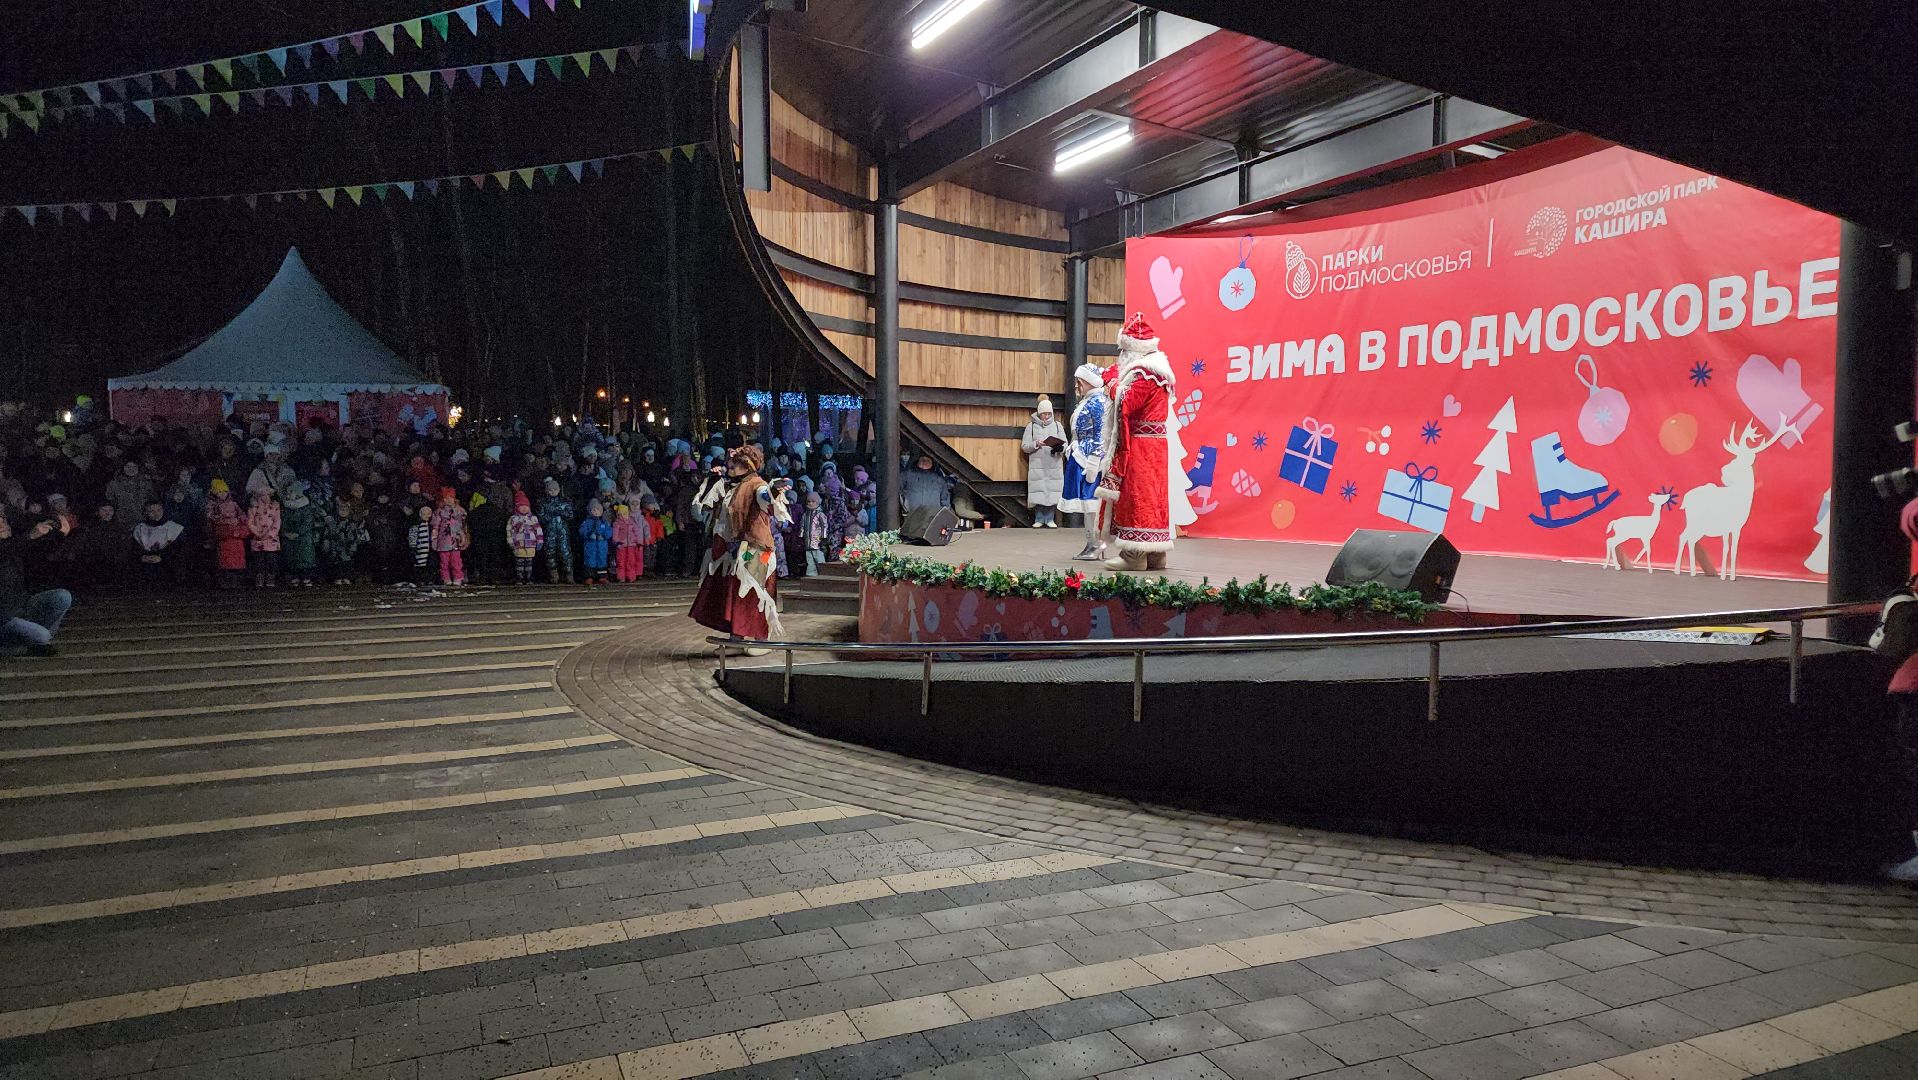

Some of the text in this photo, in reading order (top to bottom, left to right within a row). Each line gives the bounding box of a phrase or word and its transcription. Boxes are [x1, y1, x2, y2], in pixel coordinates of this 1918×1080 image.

[1576, 175, 1719, 224] ГОРОДСКОЙ ПАРК
[1574, 207, 1668, 245] КАШИРА
[1320, 249, 1473, 293] ПОДМОСКОВЬЯ
[1321, 244, 1384, 272] ПАРКИ
[1226, 256, 1841, 384] ЗИМА В ПОДМОСКОВЬЕ
